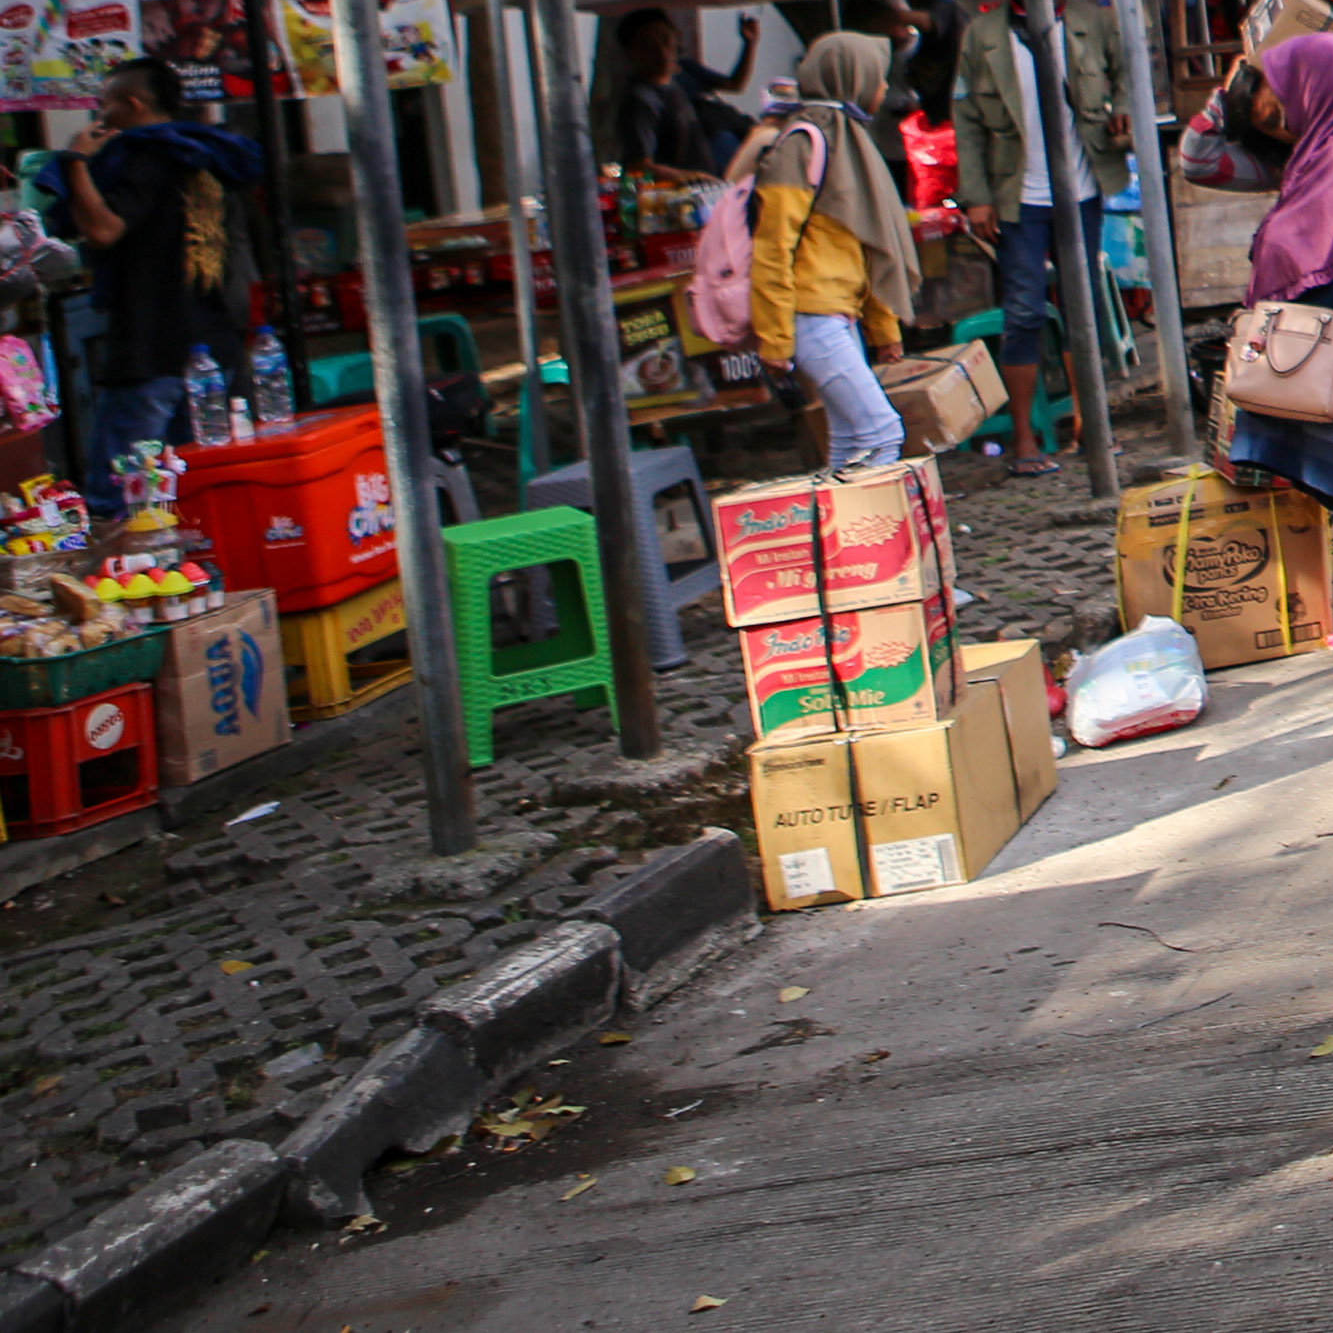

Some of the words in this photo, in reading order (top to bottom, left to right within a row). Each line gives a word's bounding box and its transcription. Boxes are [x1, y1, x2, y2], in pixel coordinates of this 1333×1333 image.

[802, 560, 880, 589] greng
[205, 632, 241, 737] AQUA
[774, 807, 825, 829] AUTO
[892, 792, 940, 815] FLAP
